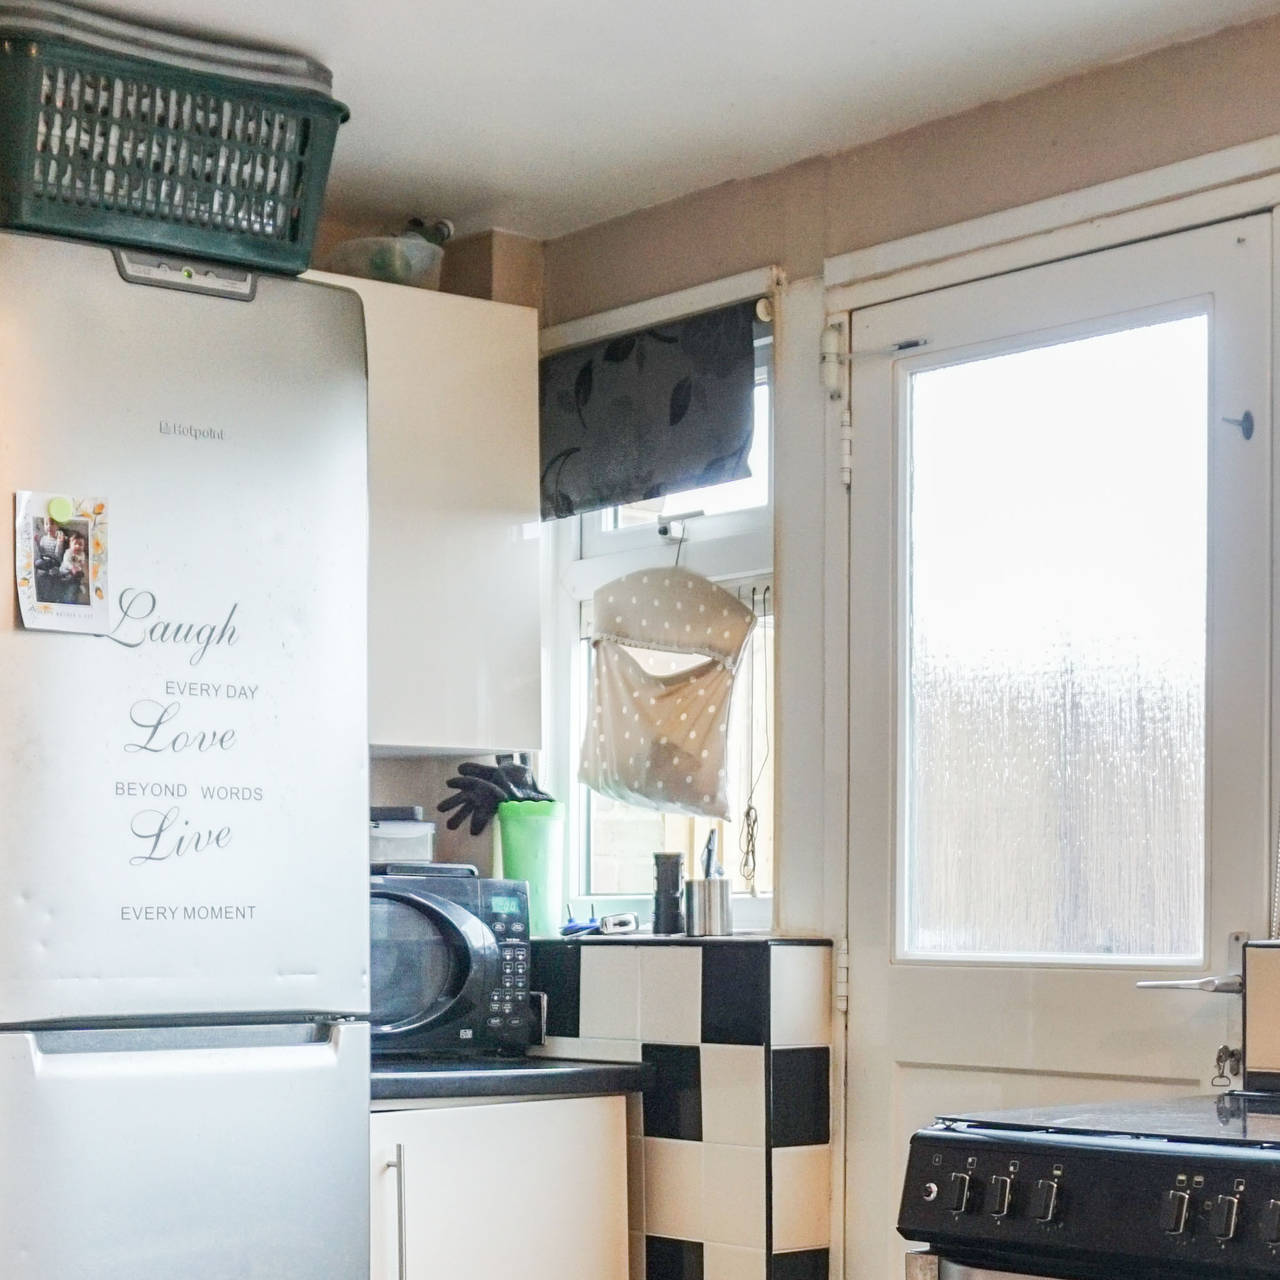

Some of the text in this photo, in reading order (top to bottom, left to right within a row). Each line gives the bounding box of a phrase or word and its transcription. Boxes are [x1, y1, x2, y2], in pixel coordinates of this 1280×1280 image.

[173, 422, 224, 441] Hotpoint
[94, 587, 240, 665] Laugh
[165, 680, 258, 699] EVERY DAY
[124, 699, 237, 753] Love
[115, 781, 264, 801] BEYOND WORDS
[129, 806, 232, 866] Live
[120, 905, 256, 921] EVERY MOMENT
